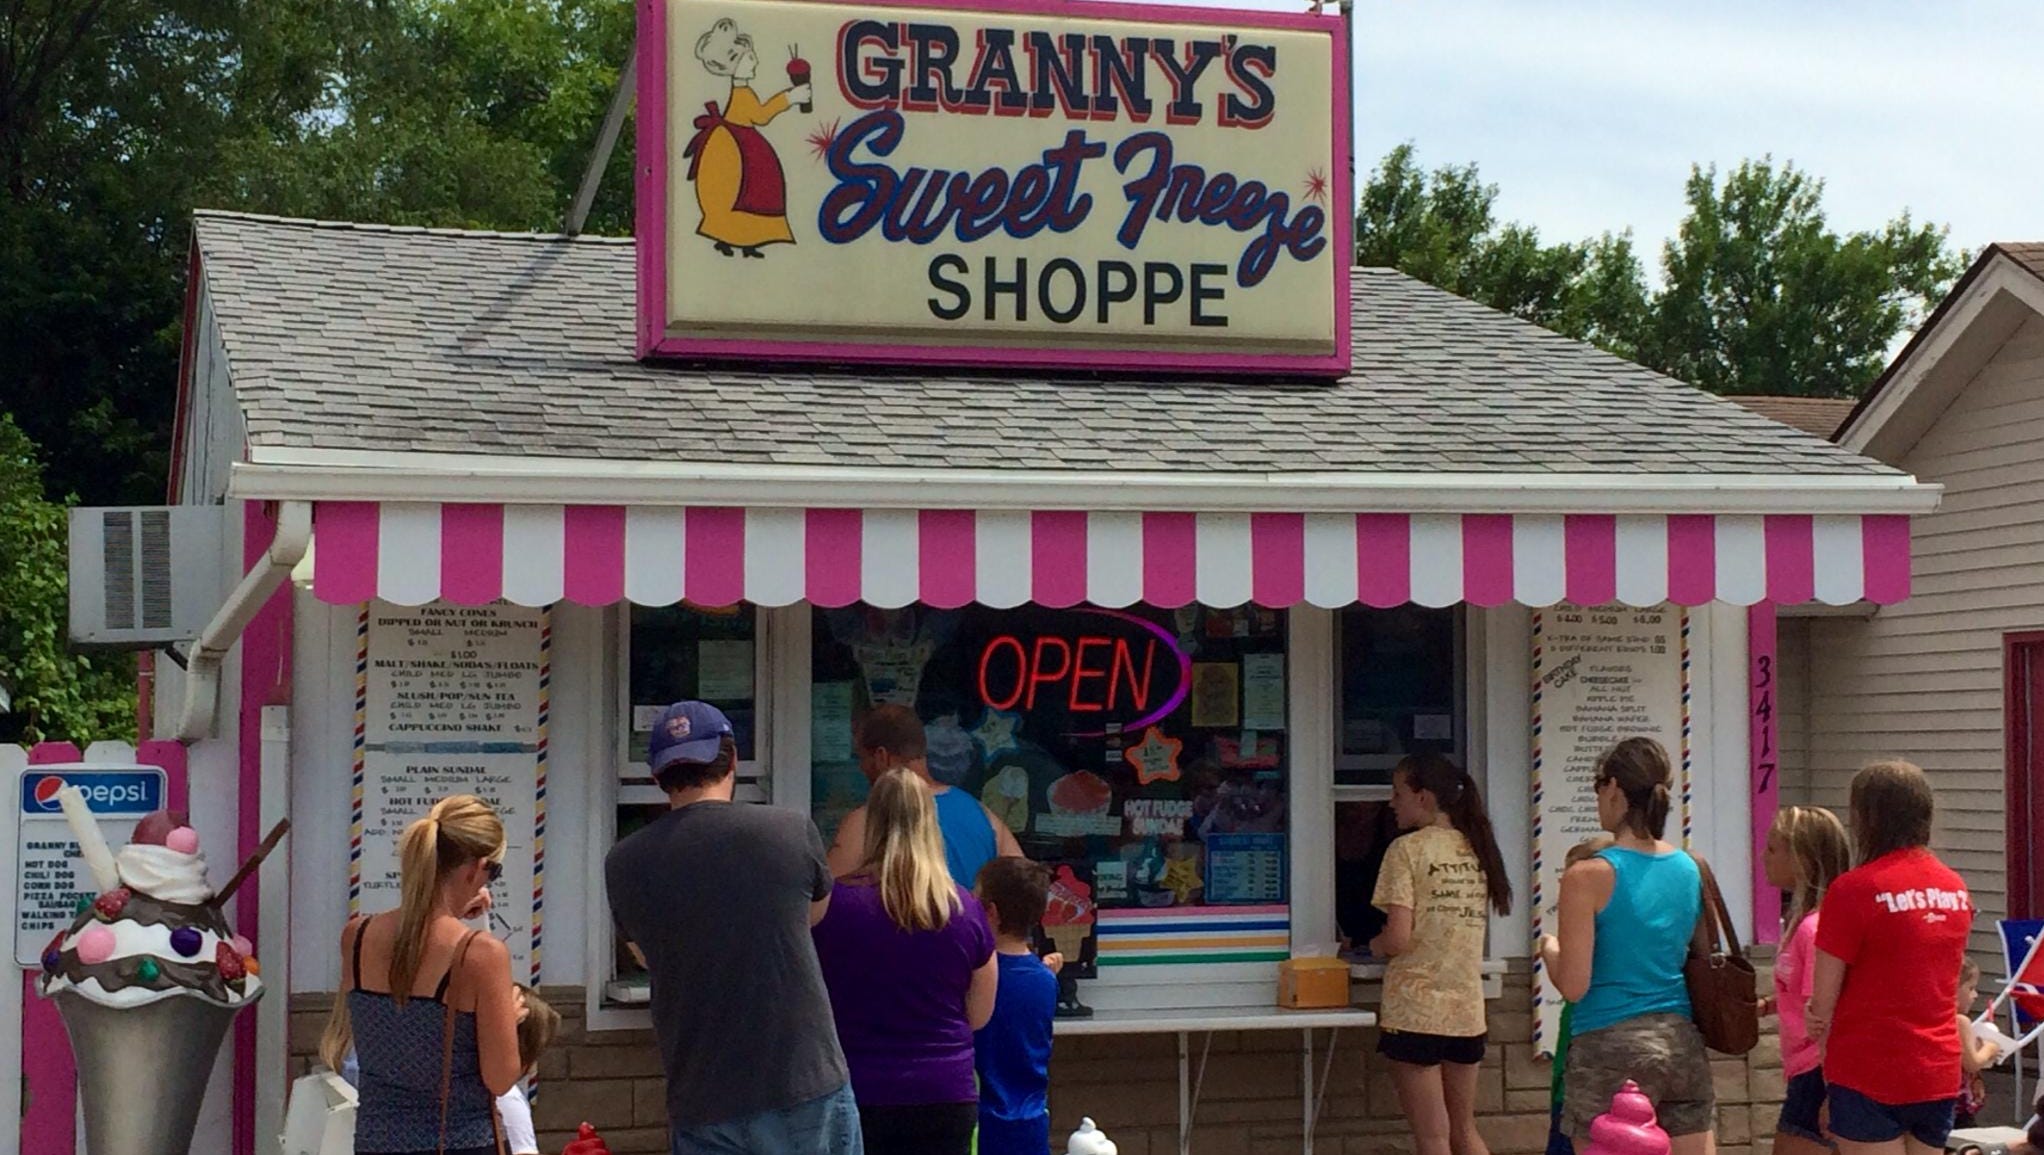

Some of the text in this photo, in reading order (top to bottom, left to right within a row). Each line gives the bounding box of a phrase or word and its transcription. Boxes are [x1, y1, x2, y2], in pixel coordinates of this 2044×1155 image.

[837, 20, 1277, 129] GRANNY'S
[817, 111, 1327, 289] Sweet Freeze
[928, 254, 1229, 326] SHOPPE
[378, 618, 421, 626] DIPPED
[425, 618, 441, 626] OR
[445, 619, 468, 627] NUT
[471, 619, 488, 627] OR
[977, 635, 1157, 711] OPEN
[1542, 655, 1581, 684] BIRTHDAY
[1554, 666, 1577, 688] CAKE
[1580, 676, 1629, 684] CHEESECAKE
[388, 724, 502, 732] CAPPUCCINO SHAKE
[1755, 655, 1775, 794] 3417
[442, 766, 486, 774] SUNDAE
[389, 797, 412, 805] HOT
[1124, 799, 1194, 817] HOT FUDGE
[27, 841, 66, 850] GRANNY
[24, 871, 74, 879] CHILI DOG
[23, 892, 54, 900] PIZZA
[21, 911, 66, 919] WALKING
[21, 922, 54, 930] CHIPS
